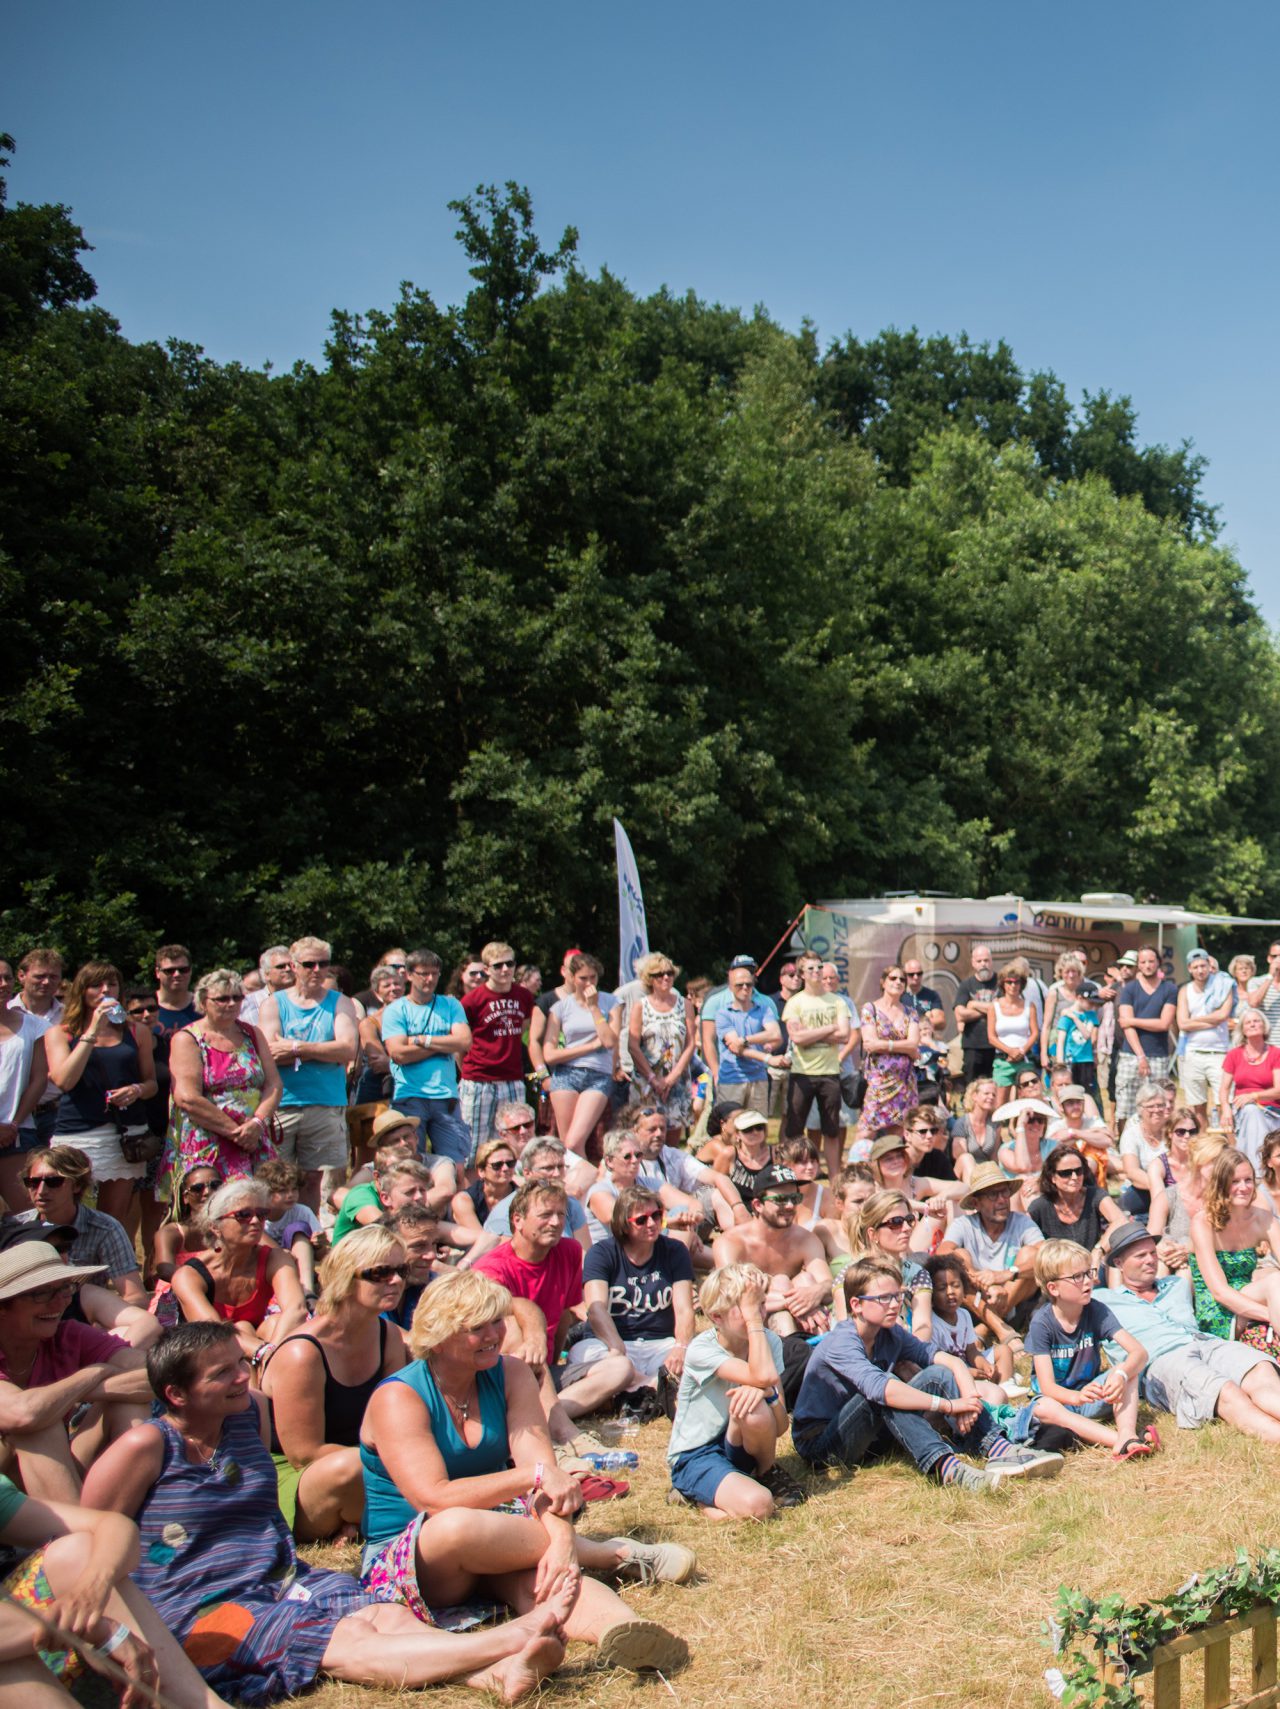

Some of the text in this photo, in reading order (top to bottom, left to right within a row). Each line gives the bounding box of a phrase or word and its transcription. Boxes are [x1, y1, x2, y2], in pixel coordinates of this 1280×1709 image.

[489, 999, 519, 1012] FITCH
[493, 1029, 507, 1037] NEW
[607, 1286, 673, 1317] Blue
